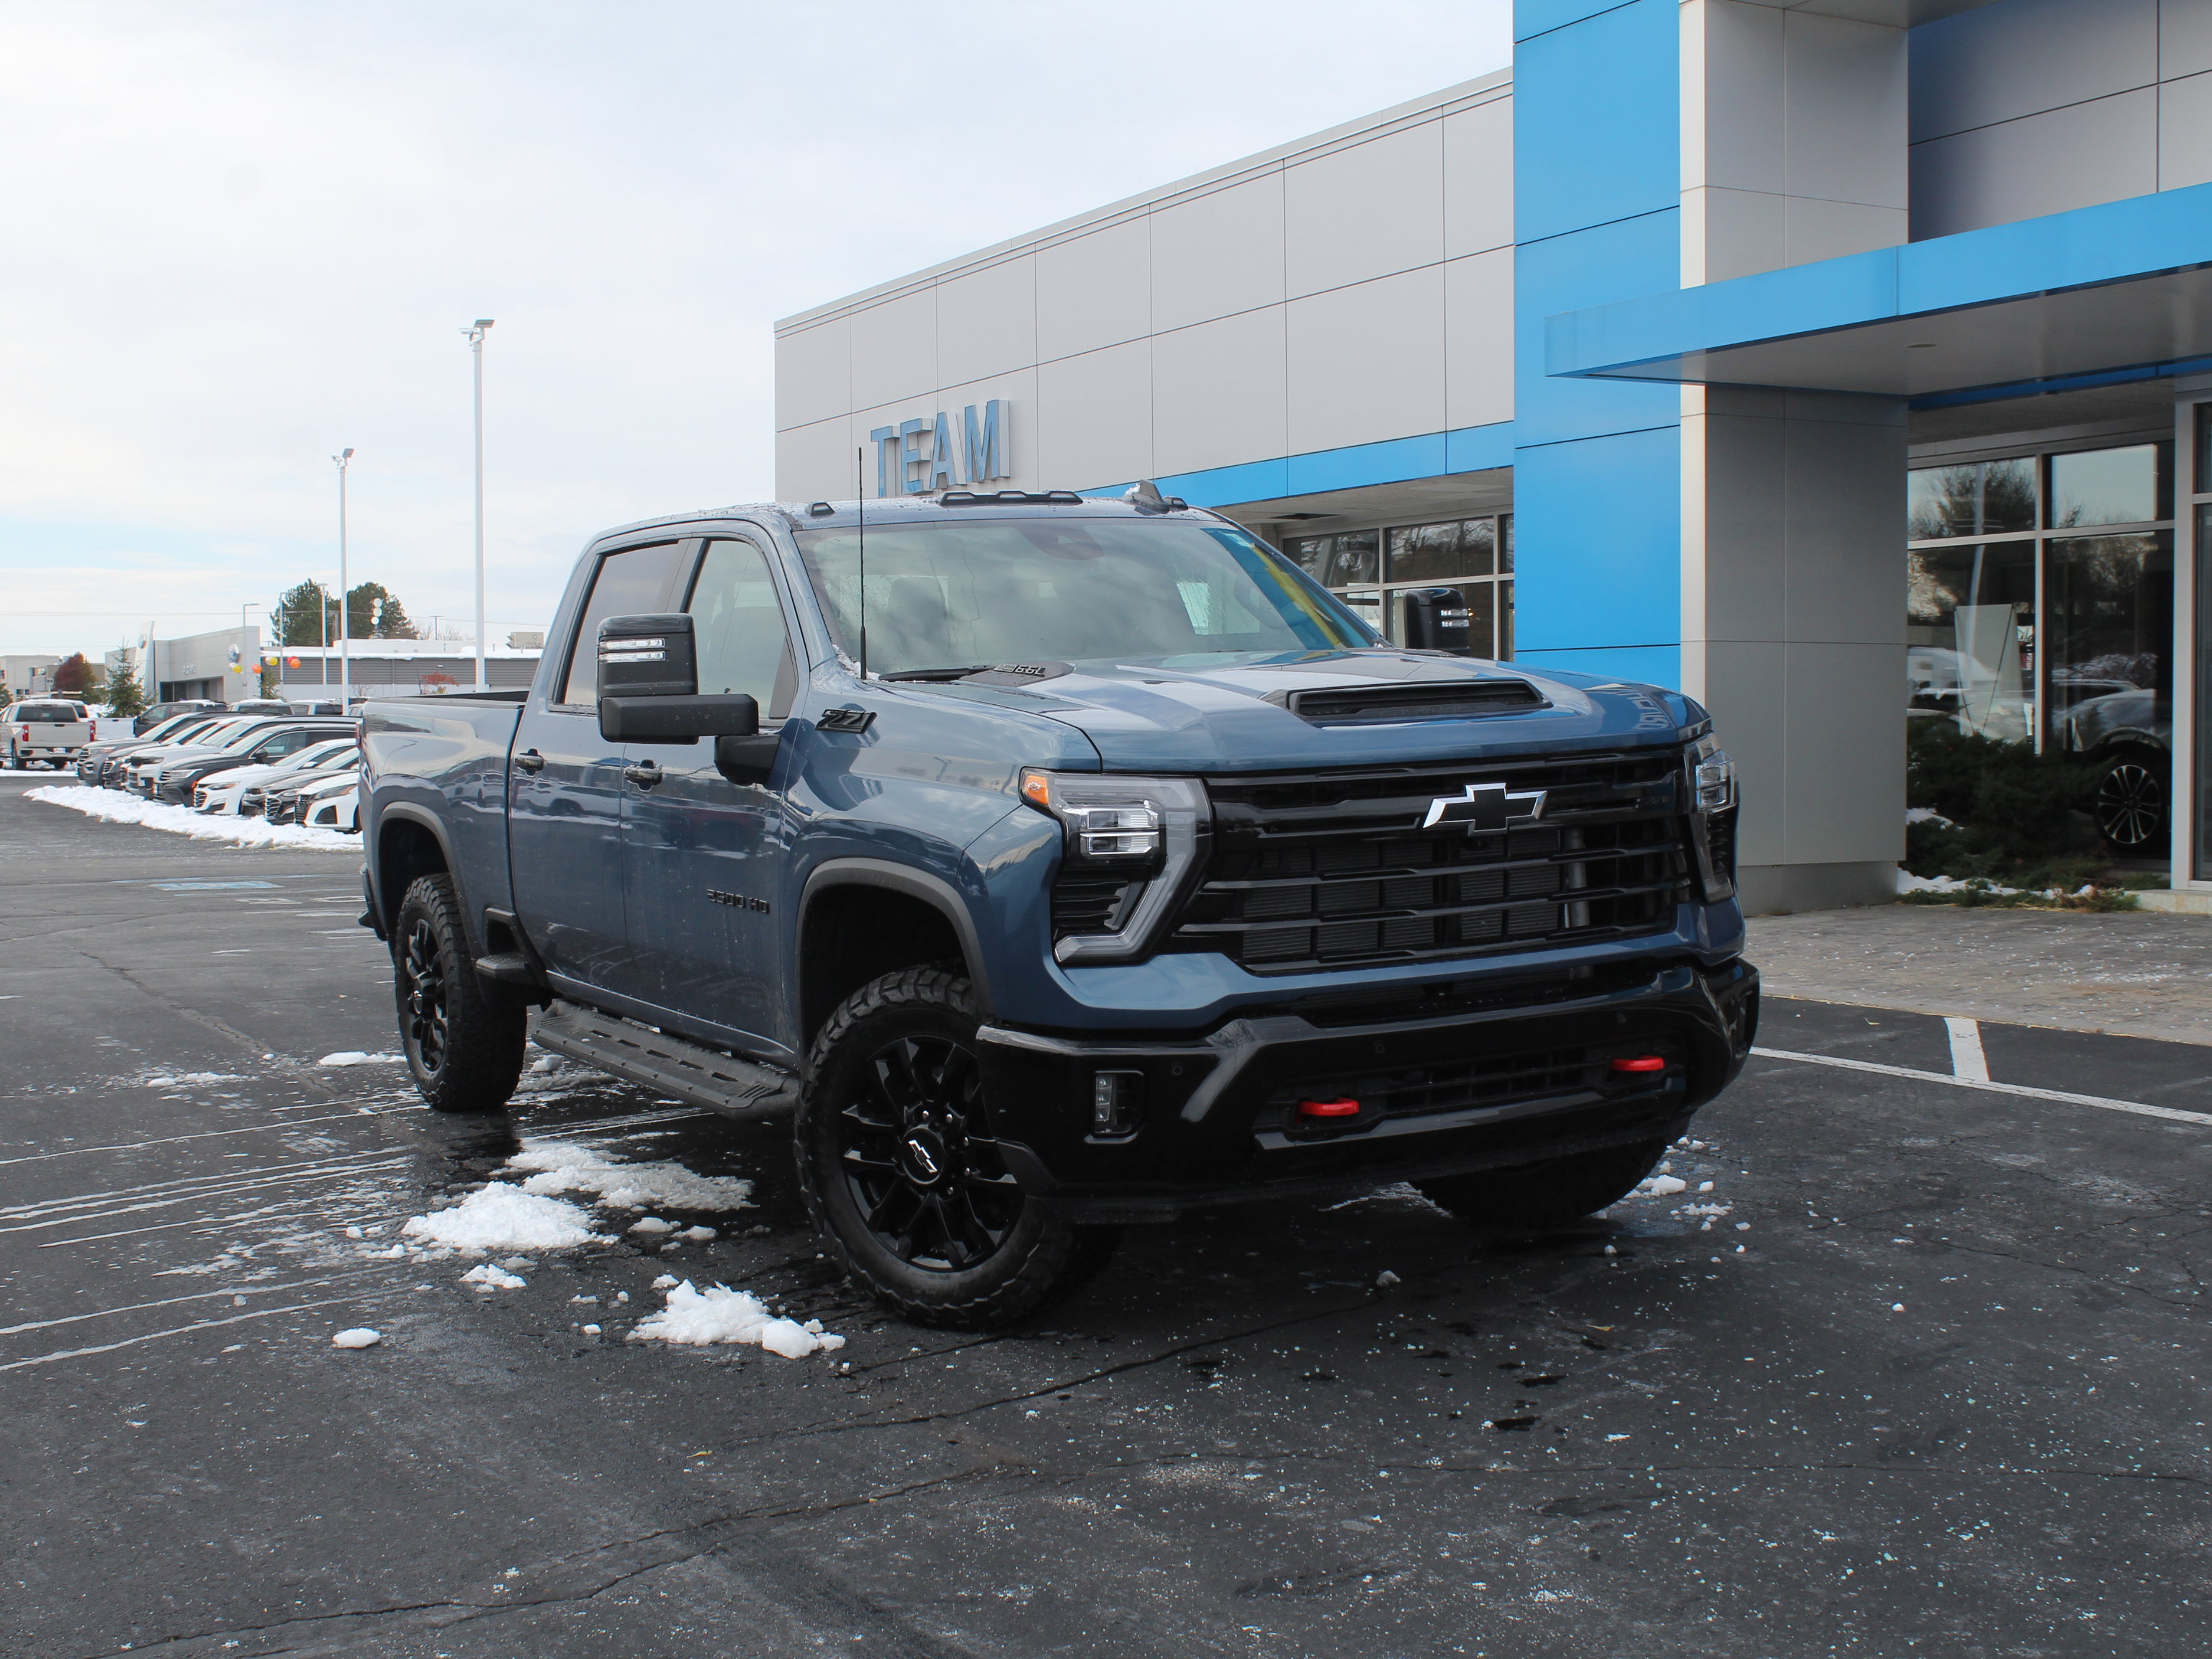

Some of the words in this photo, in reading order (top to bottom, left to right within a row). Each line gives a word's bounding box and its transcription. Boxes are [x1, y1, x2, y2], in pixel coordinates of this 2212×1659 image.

[871, 399, 1010, 498] TEAM
[815, 709, 877, 734] Z71
[749, 897, 770, 914] HD
